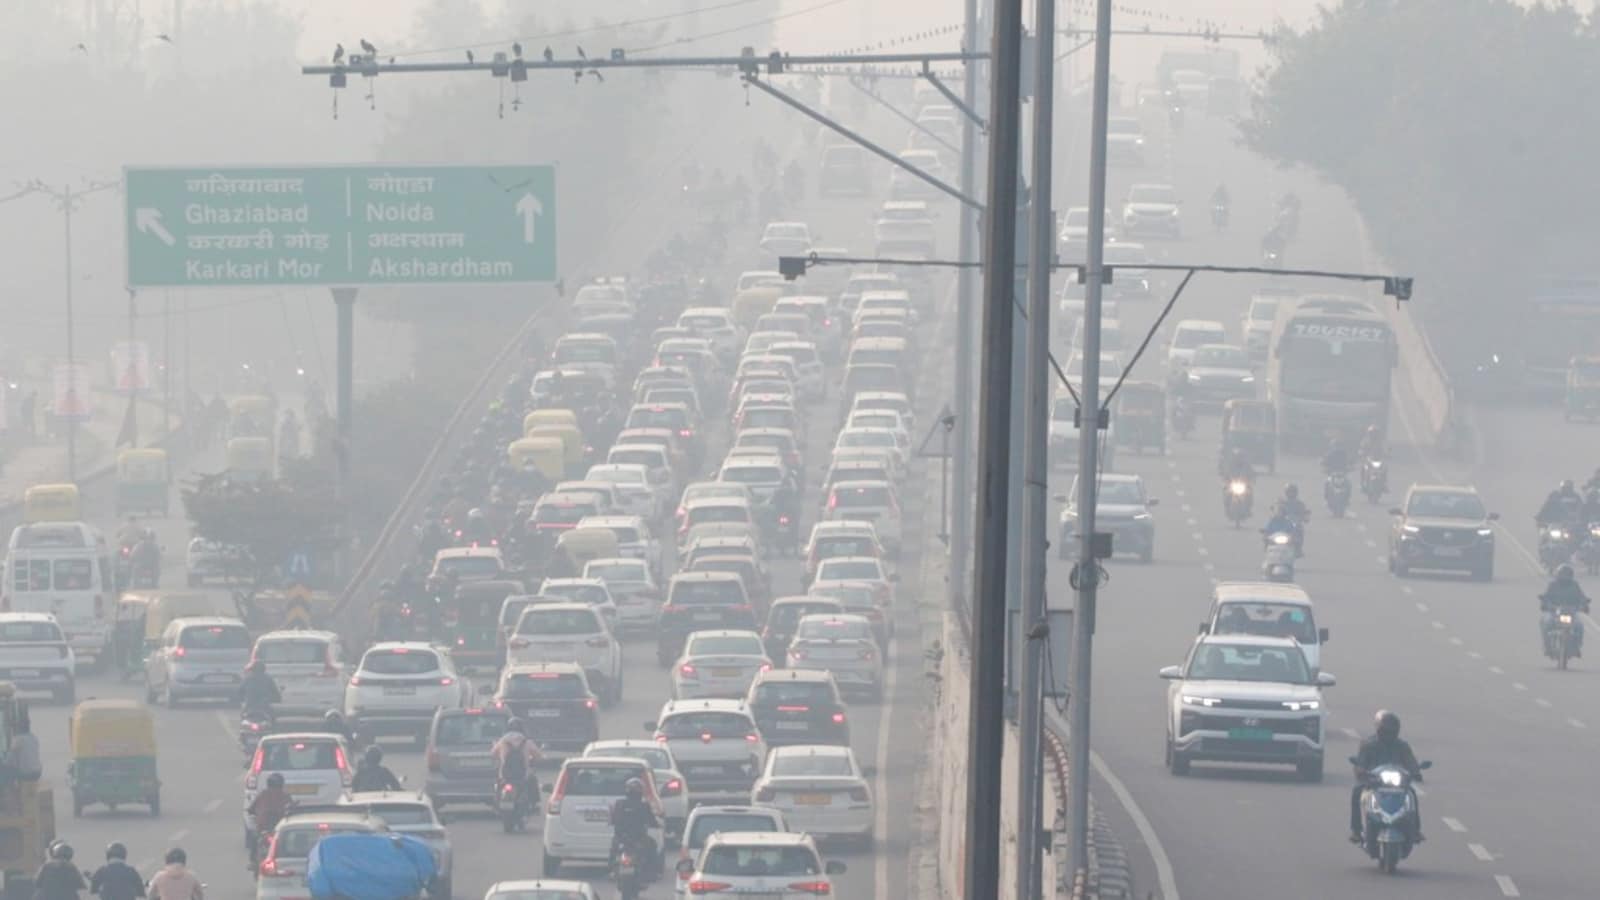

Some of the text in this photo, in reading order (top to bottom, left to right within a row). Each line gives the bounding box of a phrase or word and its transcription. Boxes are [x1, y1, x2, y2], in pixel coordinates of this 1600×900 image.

[185, 203, 309, 224] Ghaziabad
[366, 202, 434, 222] Noida
[185, 258, 322, 280] Karkari Mor
[368, 257, 513, 278] Akshardham
